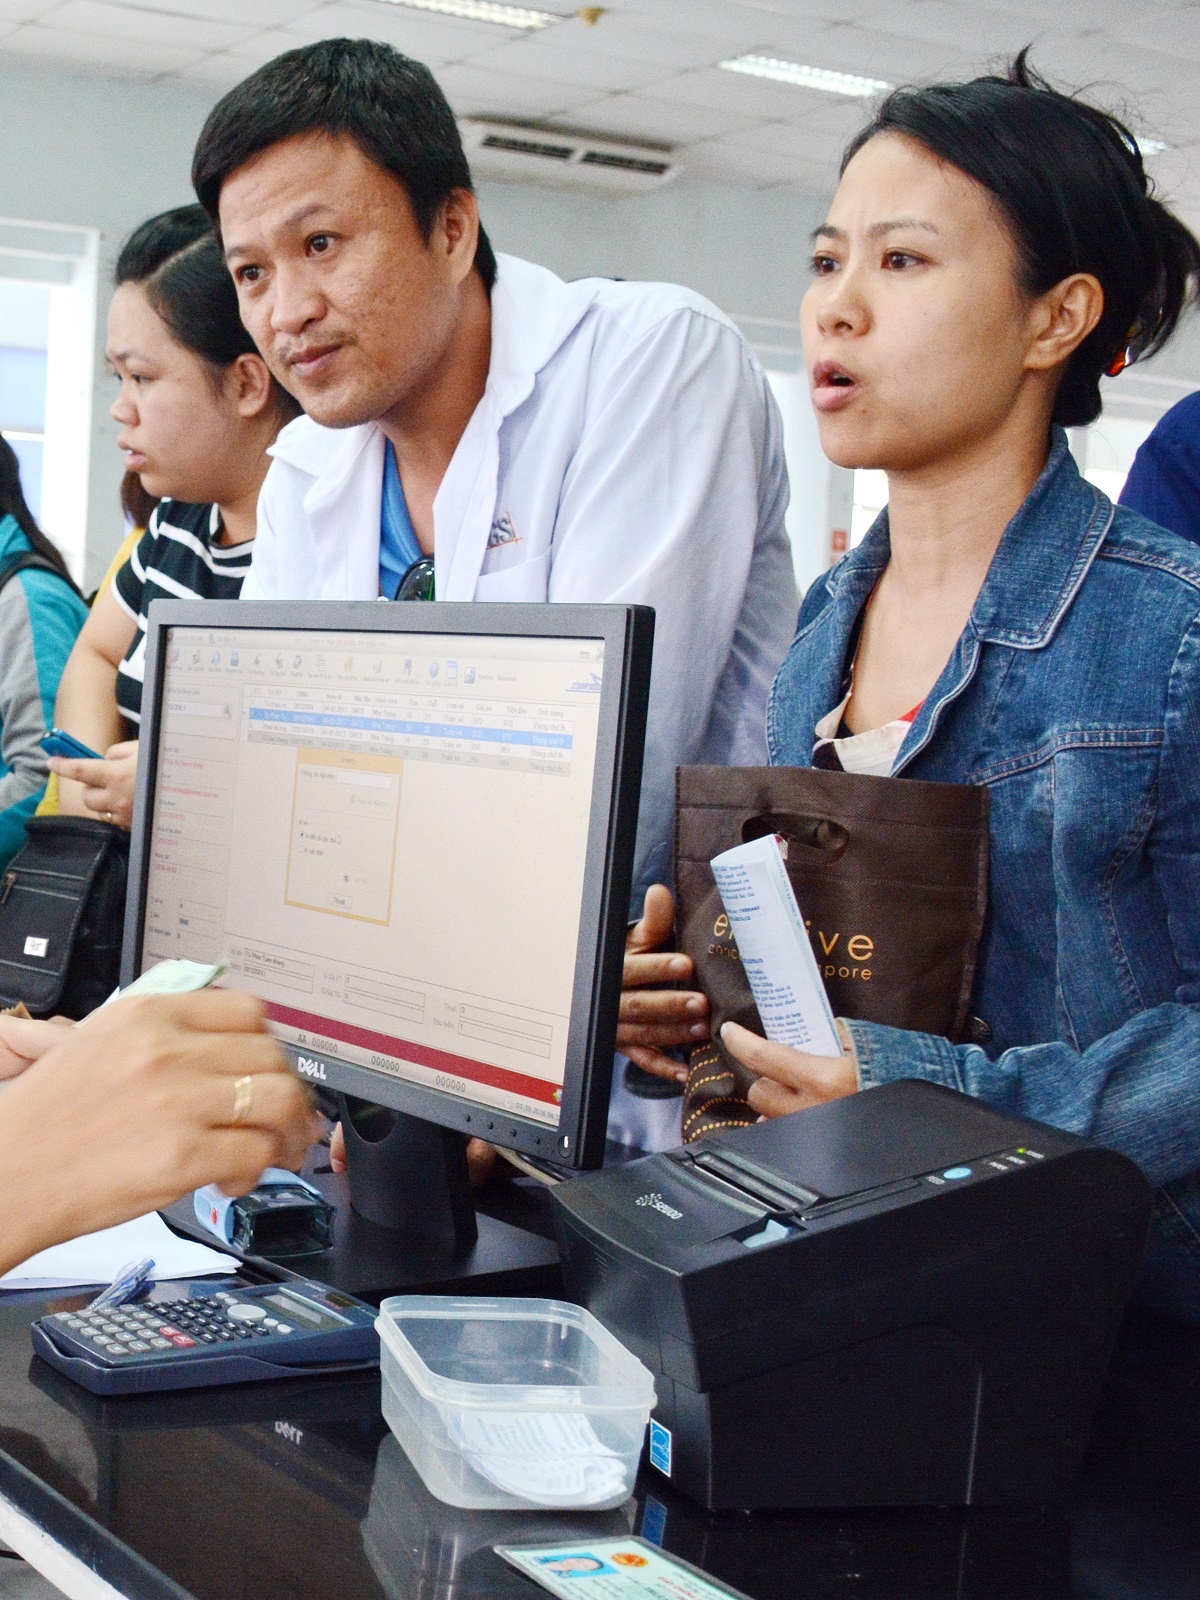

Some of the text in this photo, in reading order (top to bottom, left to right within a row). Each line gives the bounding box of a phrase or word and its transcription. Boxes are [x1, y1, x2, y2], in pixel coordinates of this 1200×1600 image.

[297, 1056, 327, 1080] DELL
[371, 1055, 400, 1073] 000000
[435, 1074, 466, 1092] 000000
